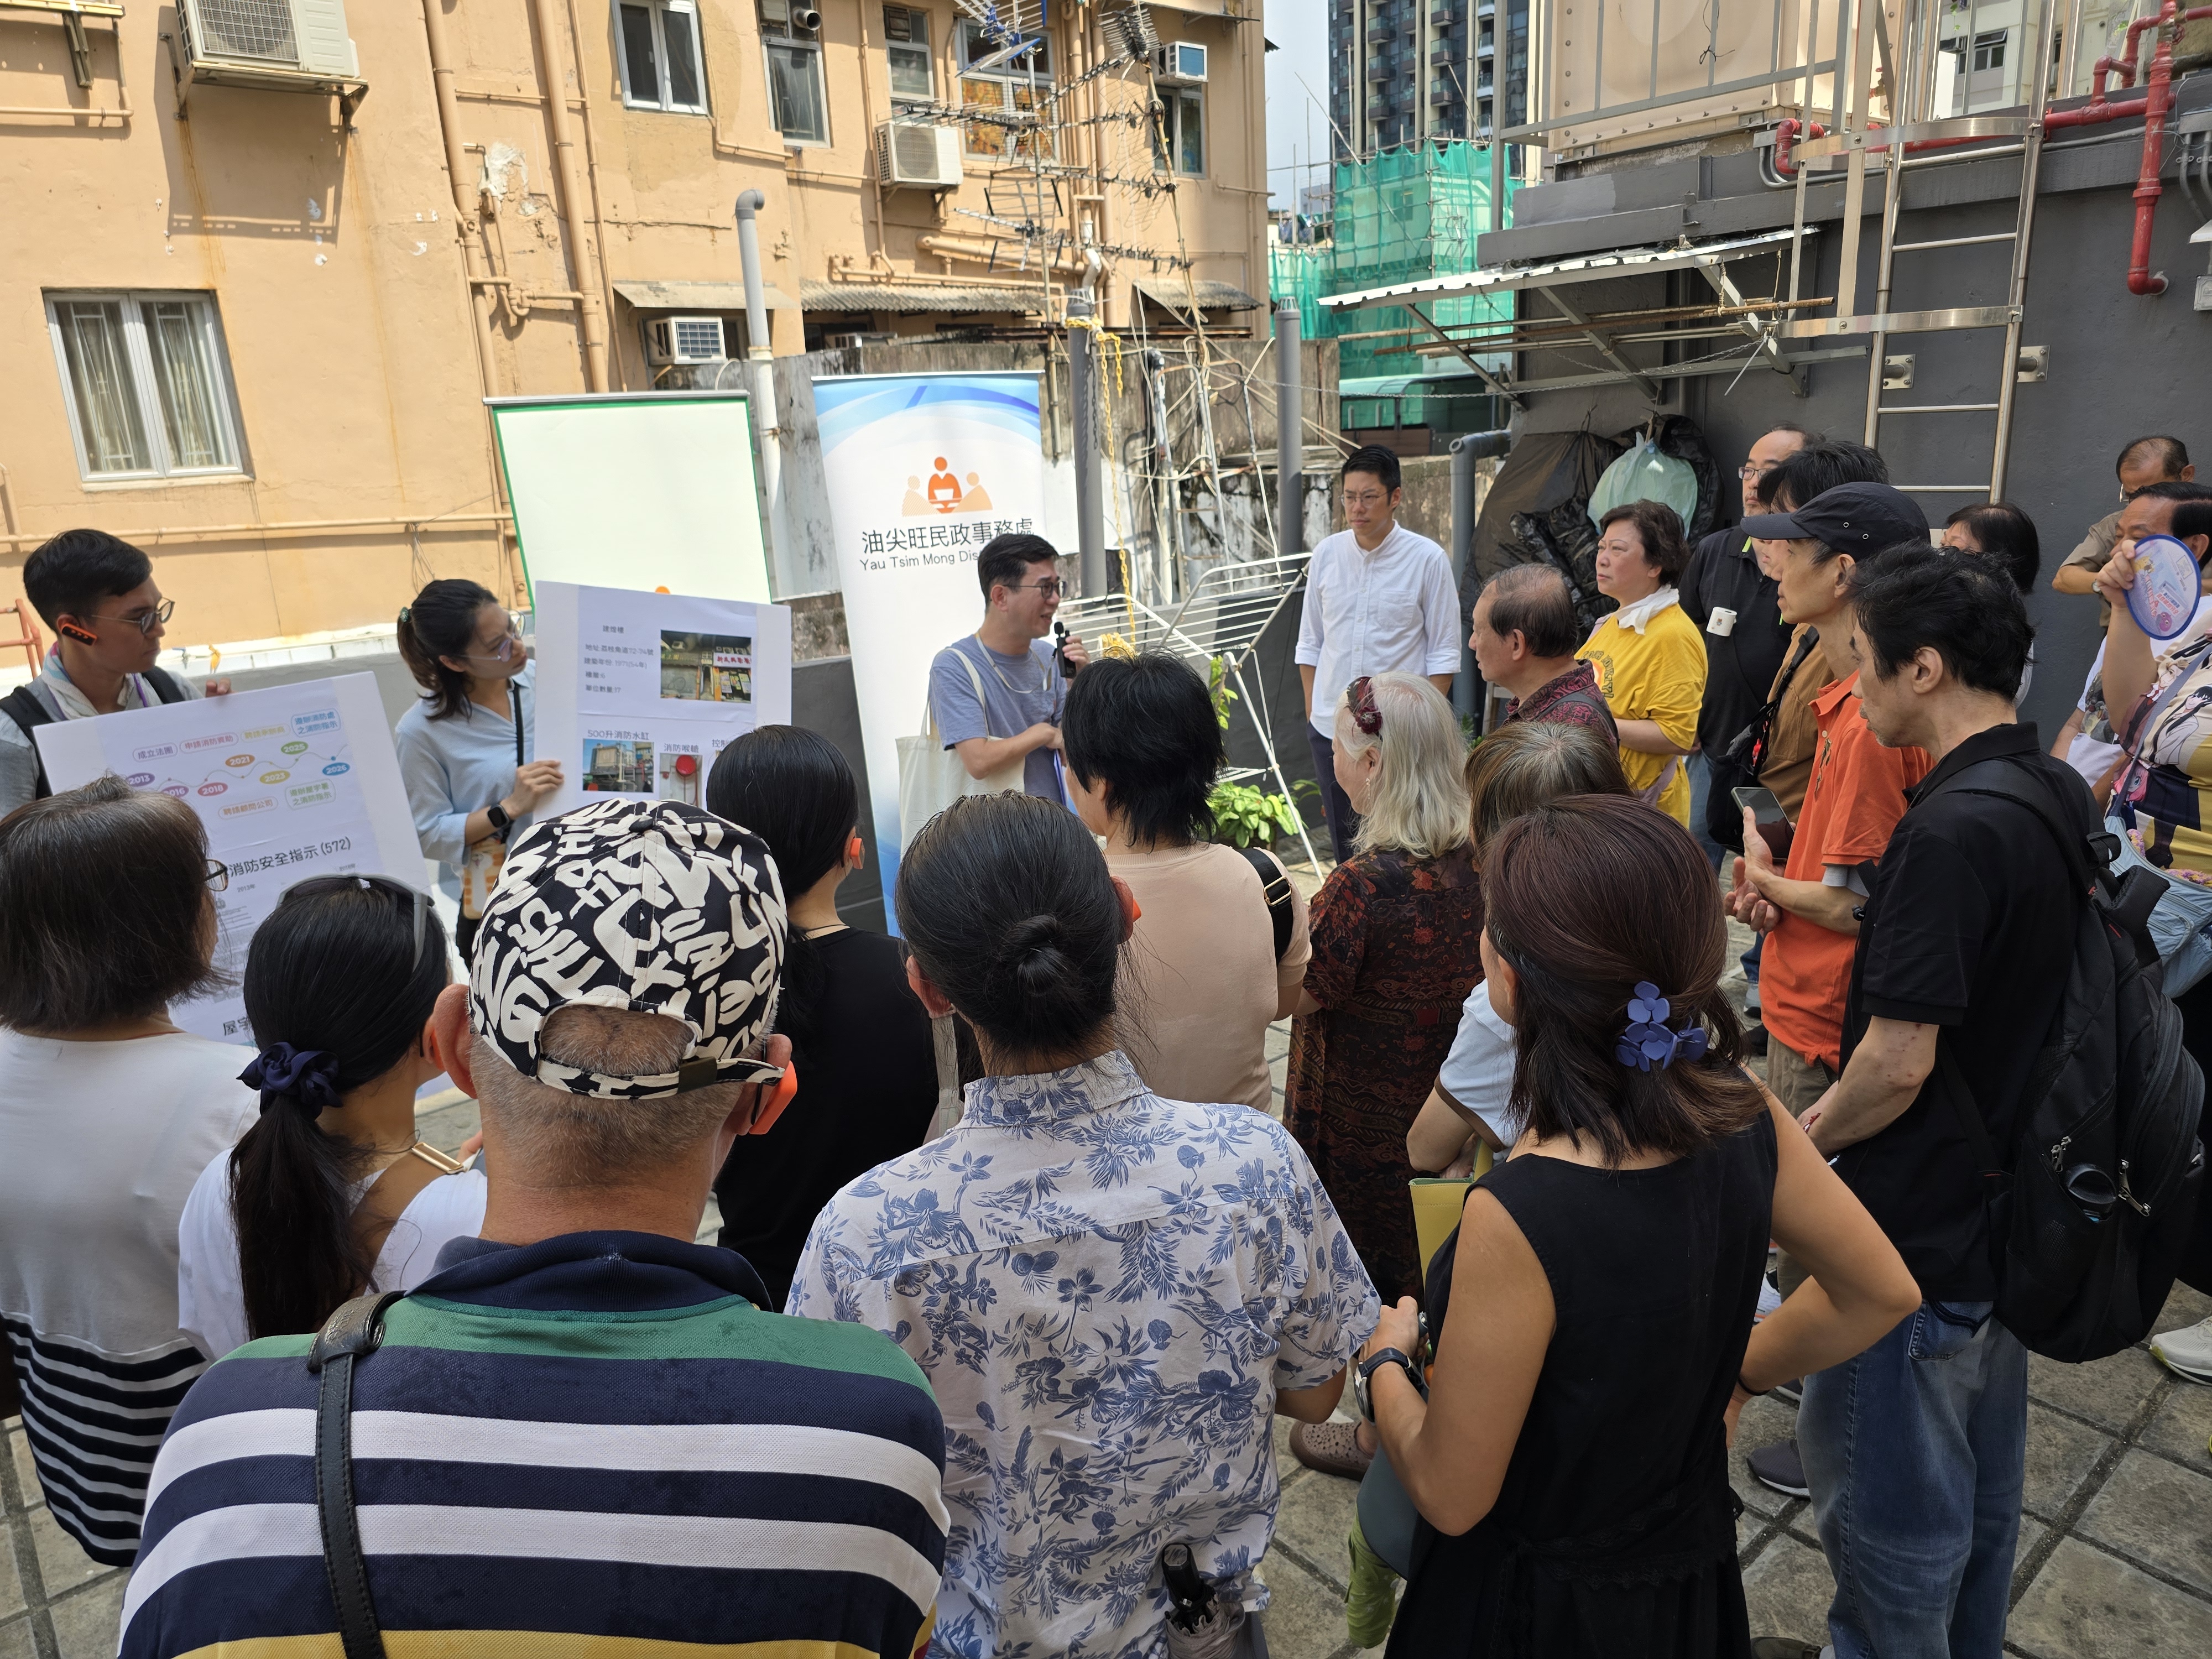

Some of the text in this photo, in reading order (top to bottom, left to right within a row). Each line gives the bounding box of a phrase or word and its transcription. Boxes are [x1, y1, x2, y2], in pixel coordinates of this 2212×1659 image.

[862, 518, 1034, 554] 油尖旺民政事務處
[860, 549, 981, 571] Yau Tsim Mong Dis
[587, 729, 649, 740] 500升消防水缸
[712, 738, 729, 747] 控制
[138, 746, 173, 760] 成立法團
[284, 744, 306, 753] 2025
[229, 756, 251, 765] 2021
[326, 765, 347, 774] 2026
[128, 775, 150, 785] 2013
[264, 773, 286, 782] 2023
[202, 785, 224, 795] 2018
[227, 836, 351, 878] 消防安全指示(572)
